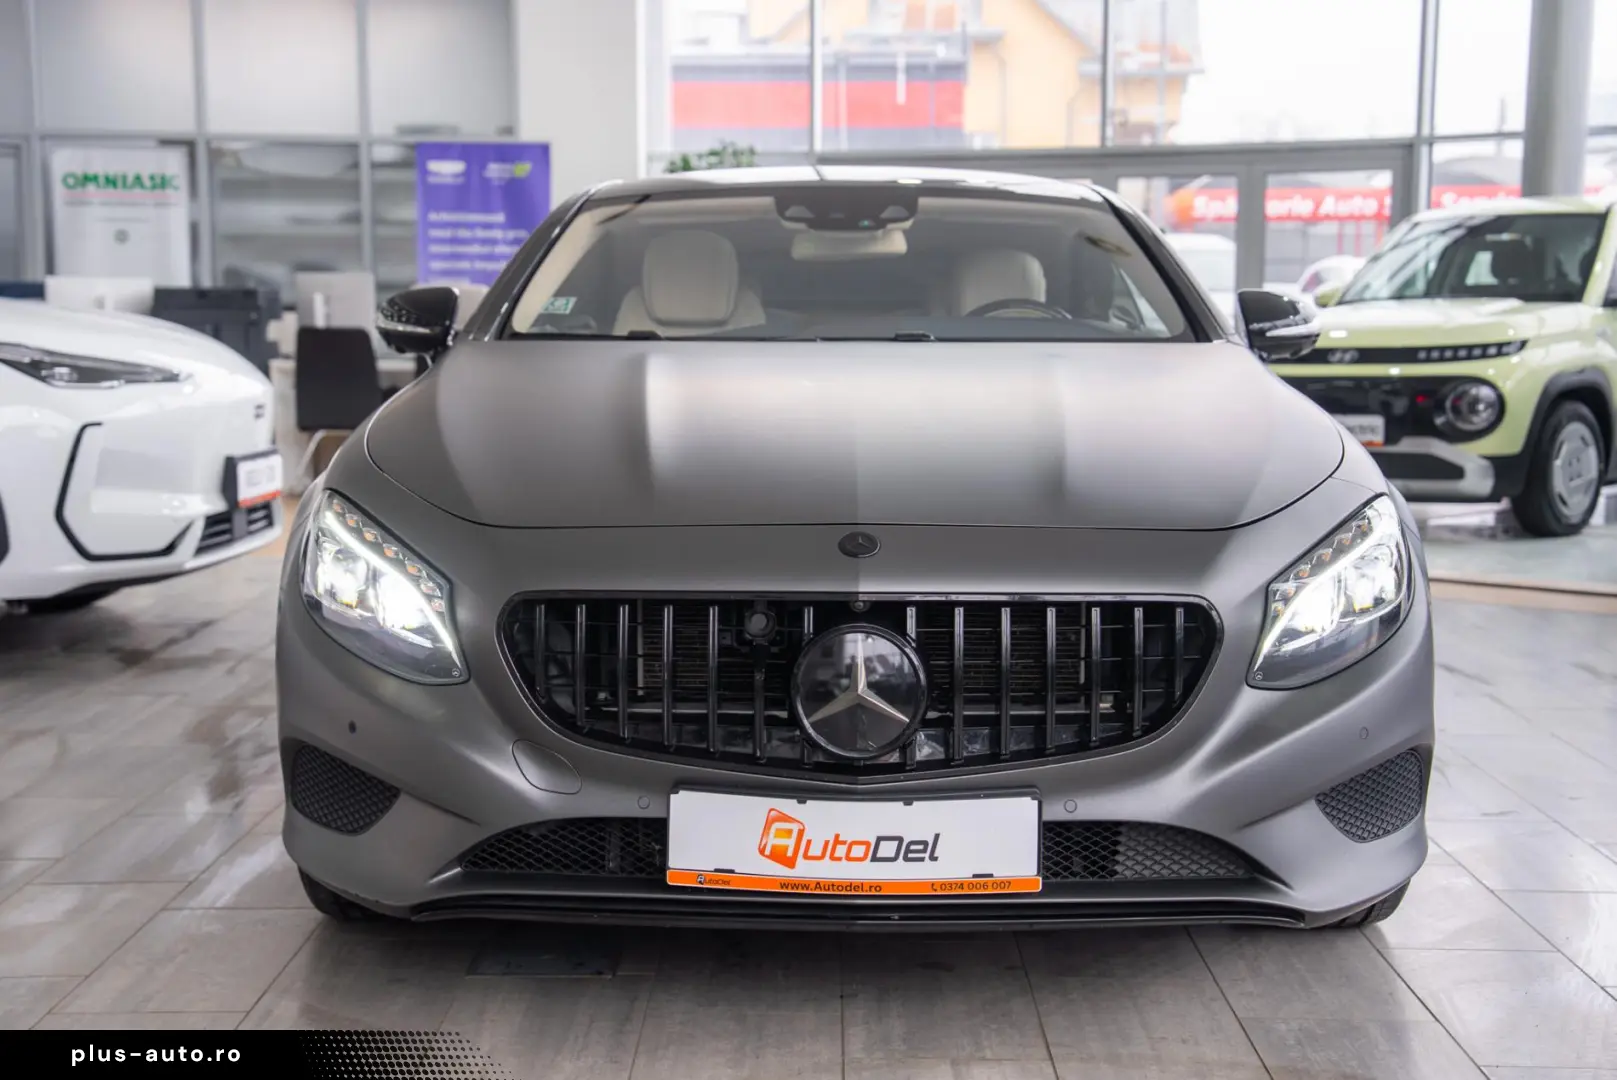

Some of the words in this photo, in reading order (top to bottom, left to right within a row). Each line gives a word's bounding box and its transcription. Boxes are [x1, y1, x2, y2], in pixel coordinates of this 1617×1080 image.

[1318, 194, 1379, 217] Auto
[761, 818, 941, 863] AutoDel
[697, 874, 732, 886] AutoDel
[779, 880, 882, 893] www.Autodel.ro
[940, 883, 964, 891] 0374
[967, 882, 989, 891] 006
[991, 881, 1012, 890] 007
